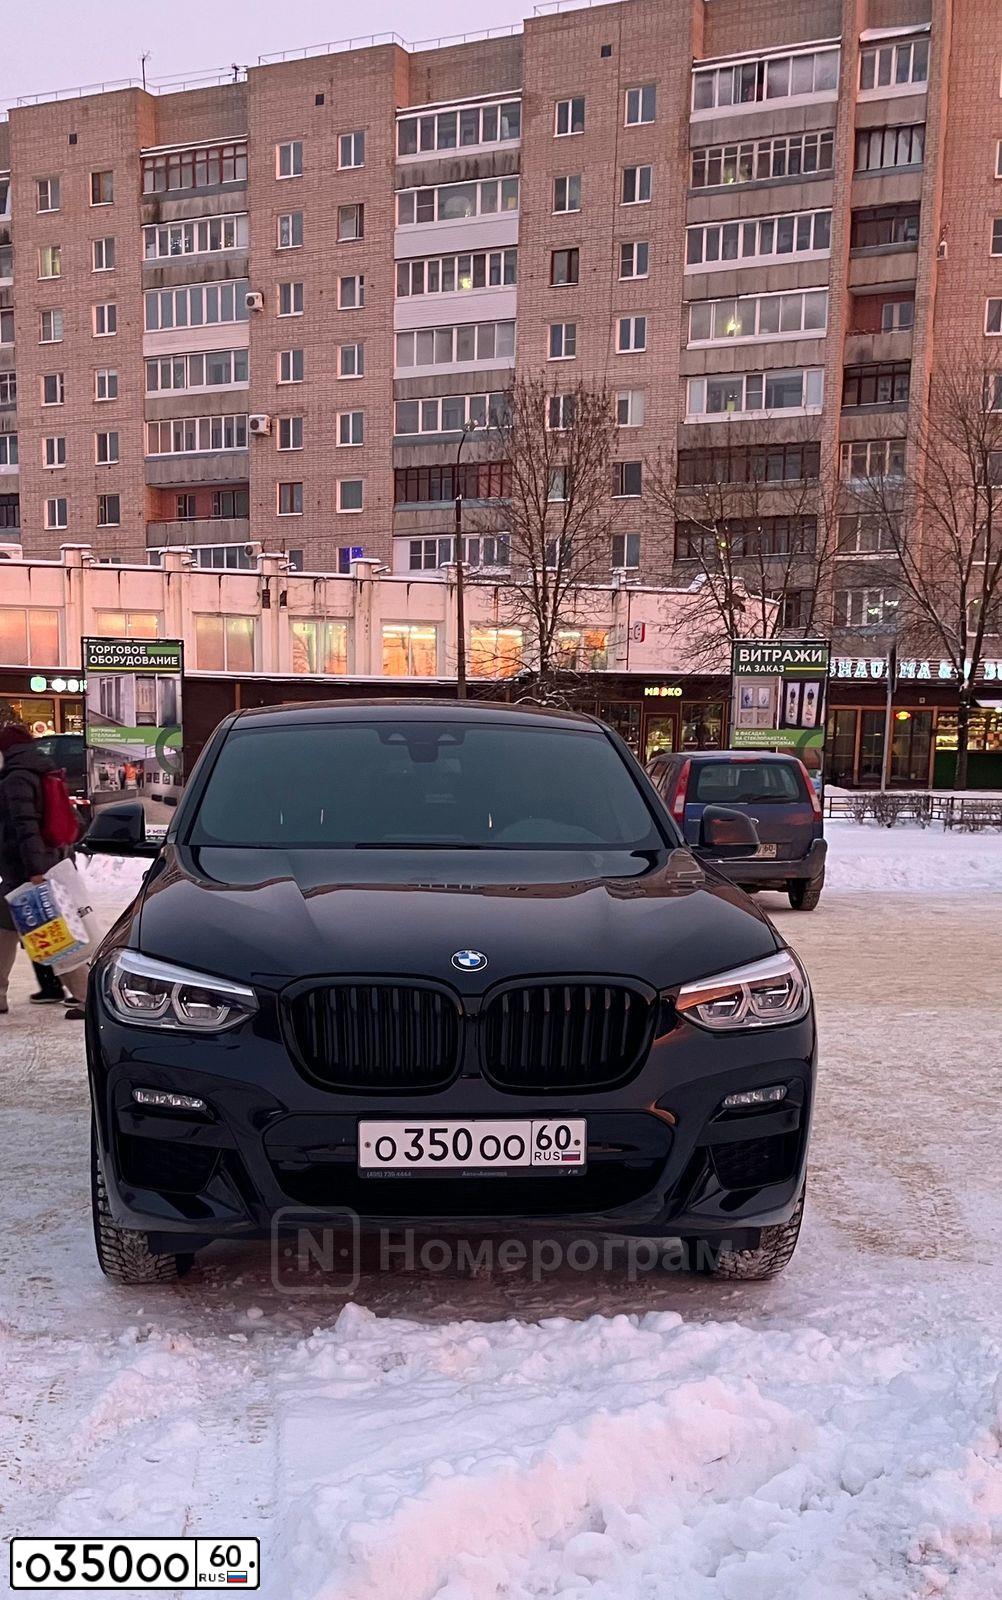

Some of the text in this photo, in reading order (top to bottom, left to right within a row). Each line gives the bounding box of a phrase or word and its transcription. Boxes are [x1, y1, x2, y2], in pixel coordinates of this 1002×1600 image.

[89, 645, 146, 654] ТОРГОВОЕ
[89, 655, 178, 666] ОБОРУДОВАНИЕ
[739, 649, 822, 662] ВИТРАЖИ
[738, 664, 785, 673] НА ЗАКАЗ
[536, 1125, 571, 1150] 60
[534, 1151, 560, 1161] RUS
